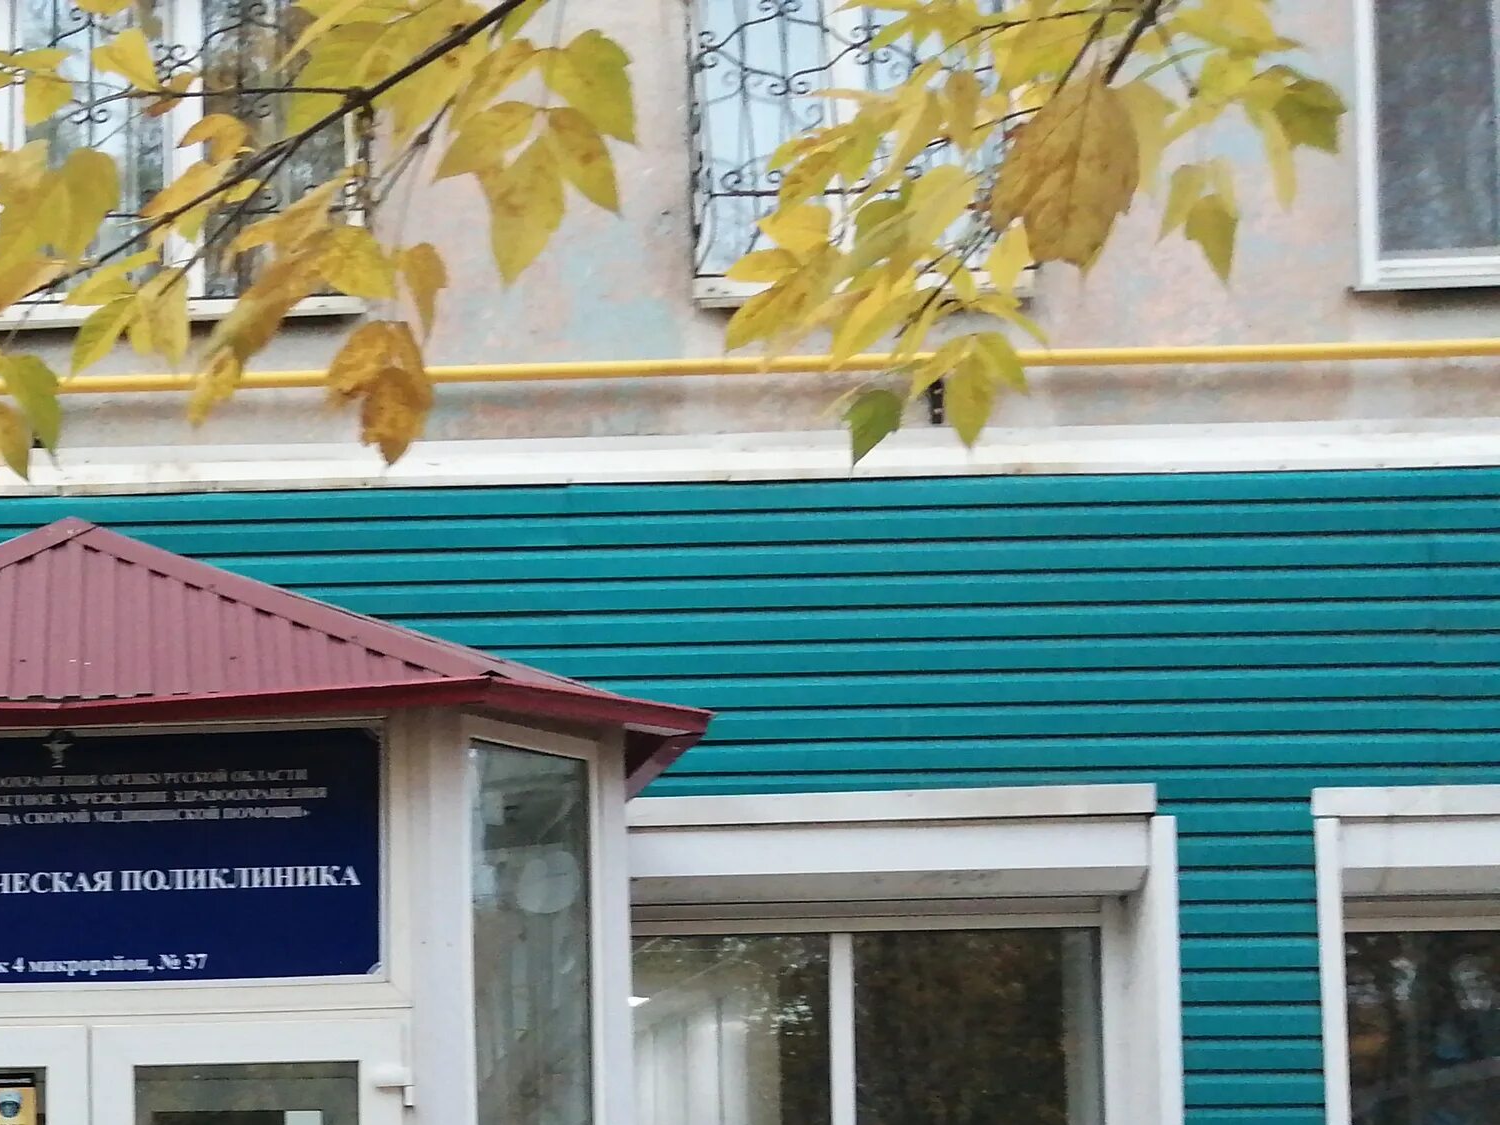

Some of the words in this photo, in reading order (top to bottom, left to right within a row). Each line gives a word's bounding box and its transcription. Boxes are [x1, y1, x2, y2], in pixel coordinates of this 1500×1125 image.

[119, 865, 362, 891] ПОЛИКЛИНИКА
[11, 956, 25, 973] 4
[156, 953, 182, 970] №
[184, 953, 208, 970] 37
